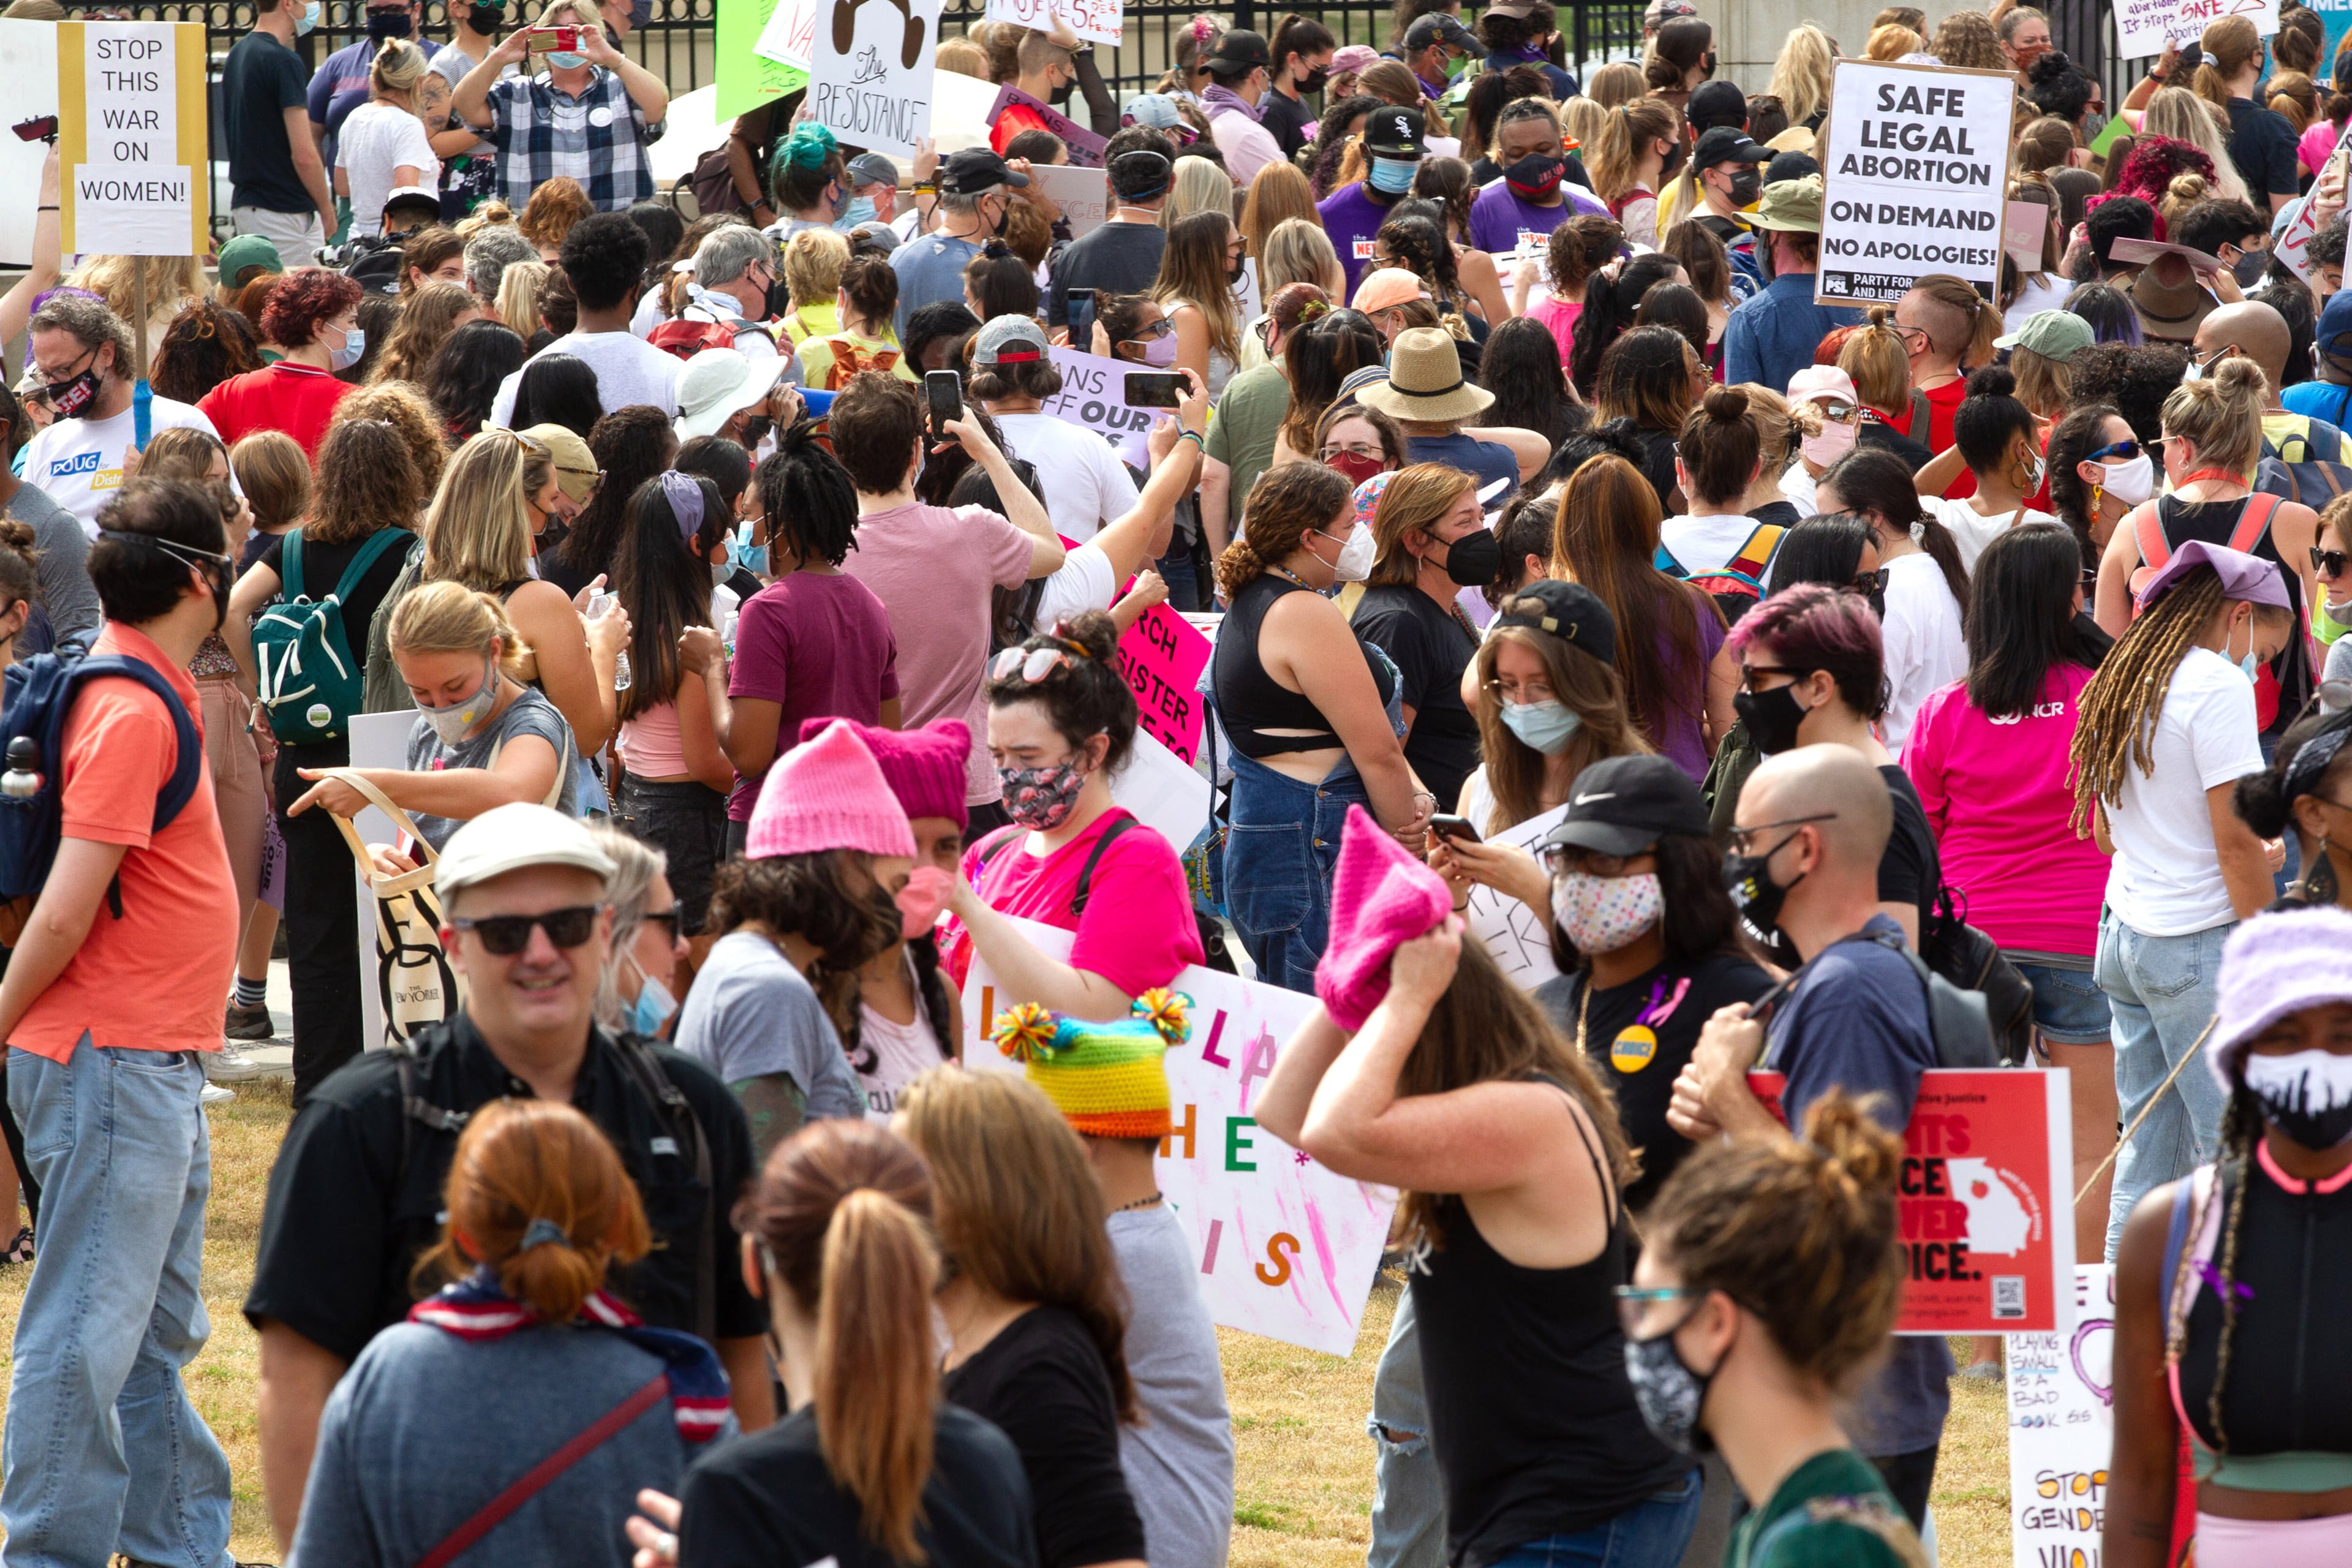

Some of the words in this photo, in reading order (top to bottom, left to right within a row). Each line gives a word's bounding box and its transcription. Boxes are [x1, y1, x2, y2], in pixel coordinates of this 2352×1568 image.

[2181, 0, 2225, 22] SAFE
[2123, 18, 2140, 34] It
[2144, 13, 2175, 29] stops
[97, 39, 162, 59] STOP
[854, 44, 887, 79] The
[102, 71, 158, 91] THIS
[1877, 83, 1965, 117] SAFE
[103, 109, 159, 130] WAR
[815, 83, 926, 146] RESISTANCE
[1861, 119, 1975, 155] LEGAL
[113, 141, 148, 161] ON
[1839, 153, 1991, 186] ABORTION
[81, 181, 184, 202] WOMEN!
[1830, 201, 1873, 223] ON
[1878, 204, 1996, 232] DEMAND
[1825, 238, 1859, 256] NO
[1863, 241, 1997, 266] APOLOGIES!
[1825, 282, 1849, 294] PSL
[1853, 274, 1888, 287] PARTY
[1891, 276, 1913, 288] FOR
[1852, 287, 1875, 299] AND
[1080, 401, 1151, 432] OUR
[52, 455, 97, 477] DOUG
[94, 473, 123, 488] Distr
[2010, 1334, 2059, 1351] PLAYING
[2035, 1375, 2048, 1386] A
[2013, 1391, 2059, 1407] BAD
[2010, 1411, 2060, 1428] LOOK
